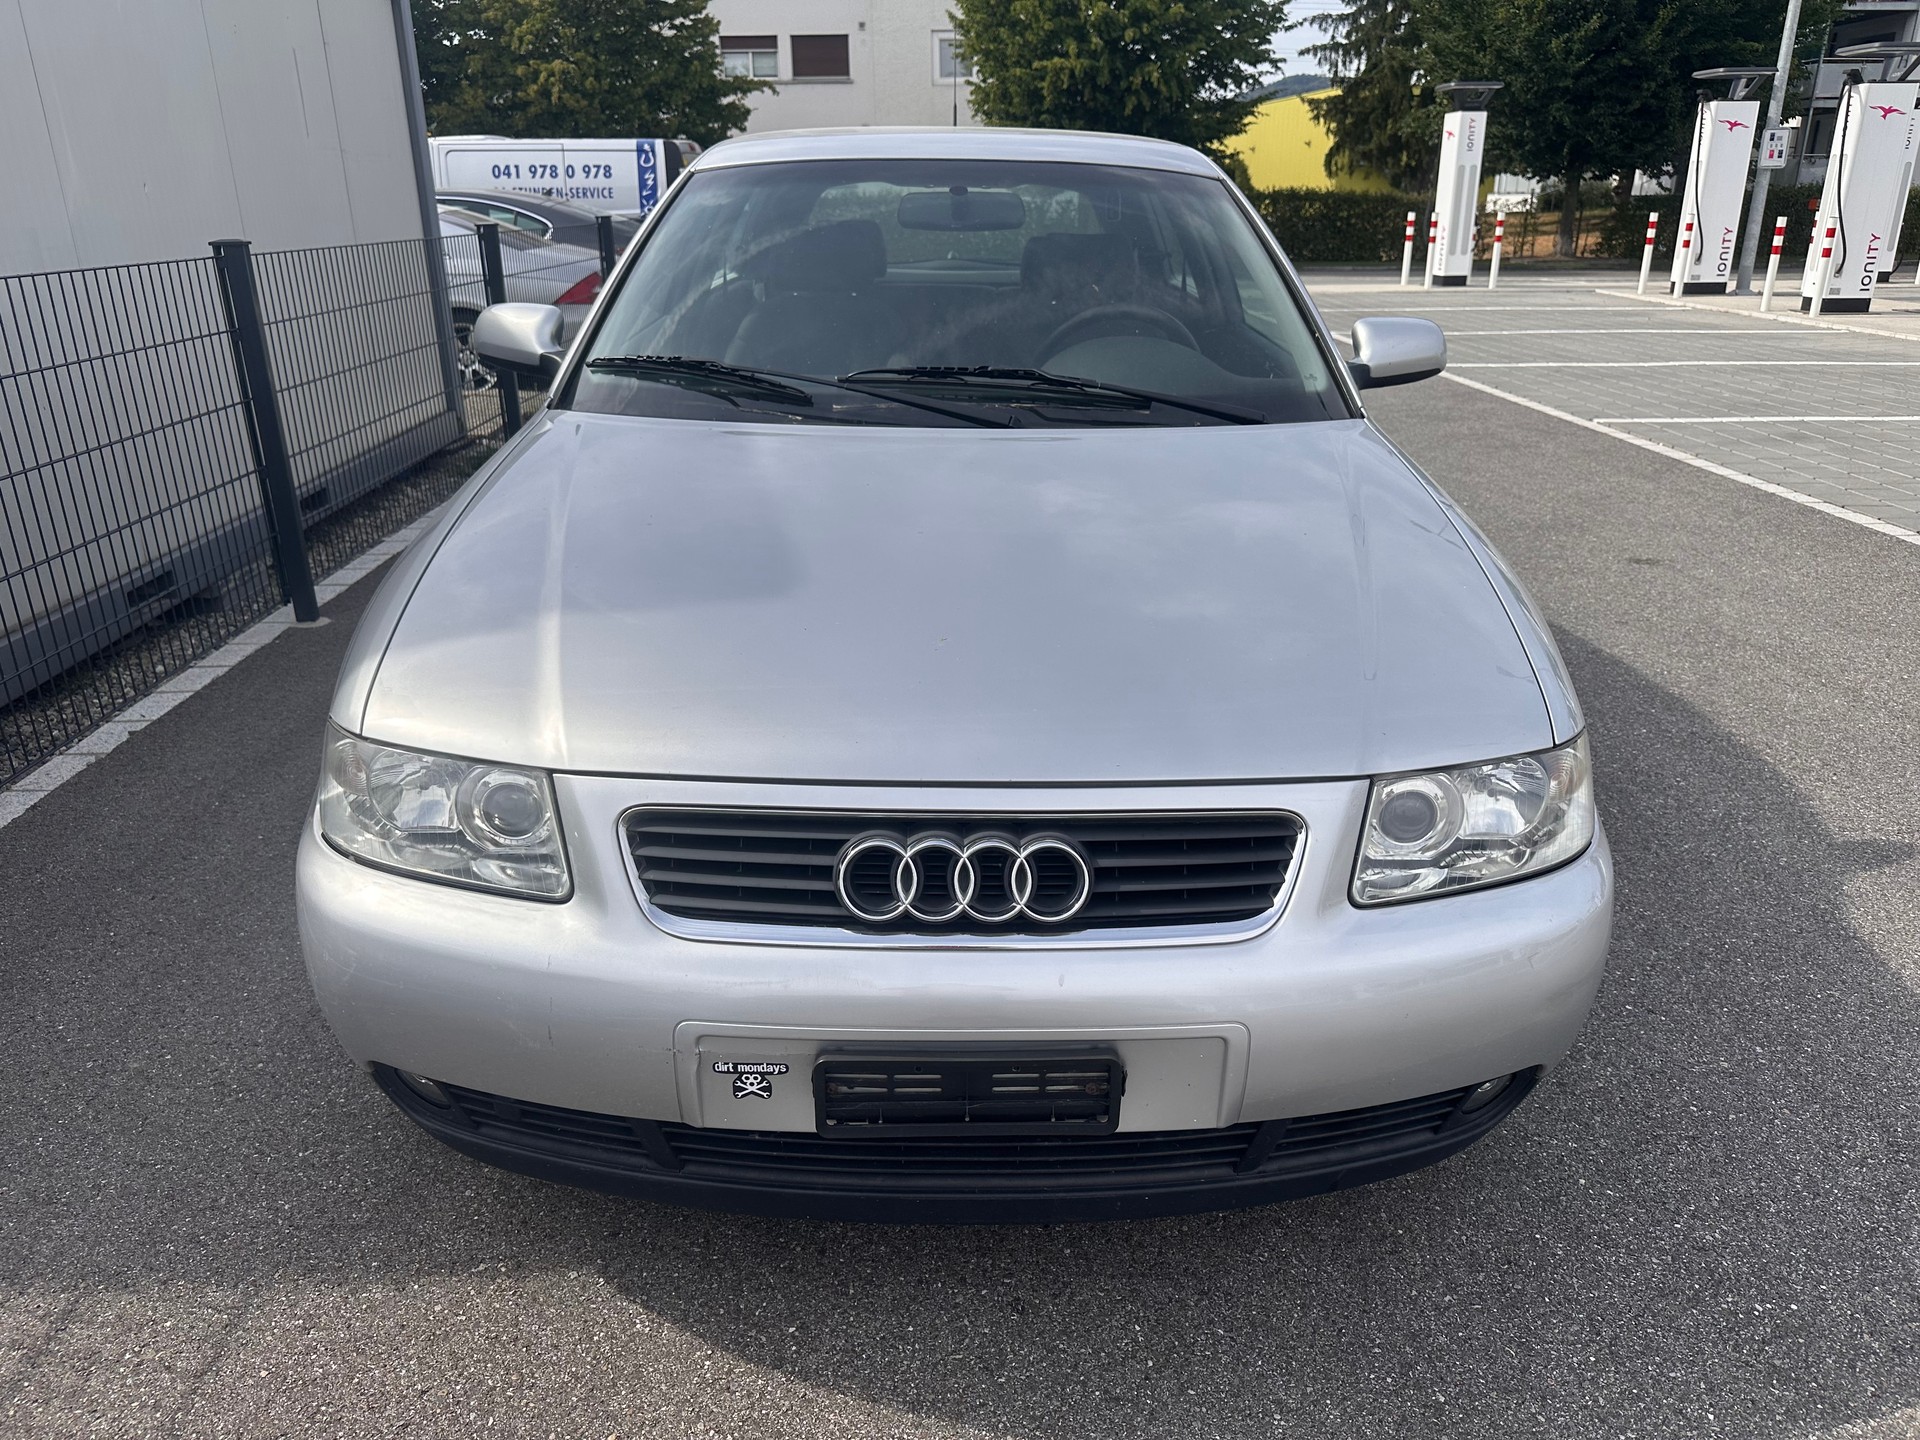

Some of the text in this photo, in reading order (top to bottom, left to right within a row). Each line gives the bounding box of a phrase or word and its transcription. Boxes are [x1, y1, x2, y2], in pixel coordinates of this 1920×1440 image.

[1466, 117, 1477, 152] IONITY
[492, 164, 613, 179] 041 978 0 978
[512, 186, 614, 199] NDN-SERVICE
[1716, 226, 1734, 277] IONITY
[1859, 232, 1881, 292] IONITY
[714, 1061, 787, 1075] dirt mondays
